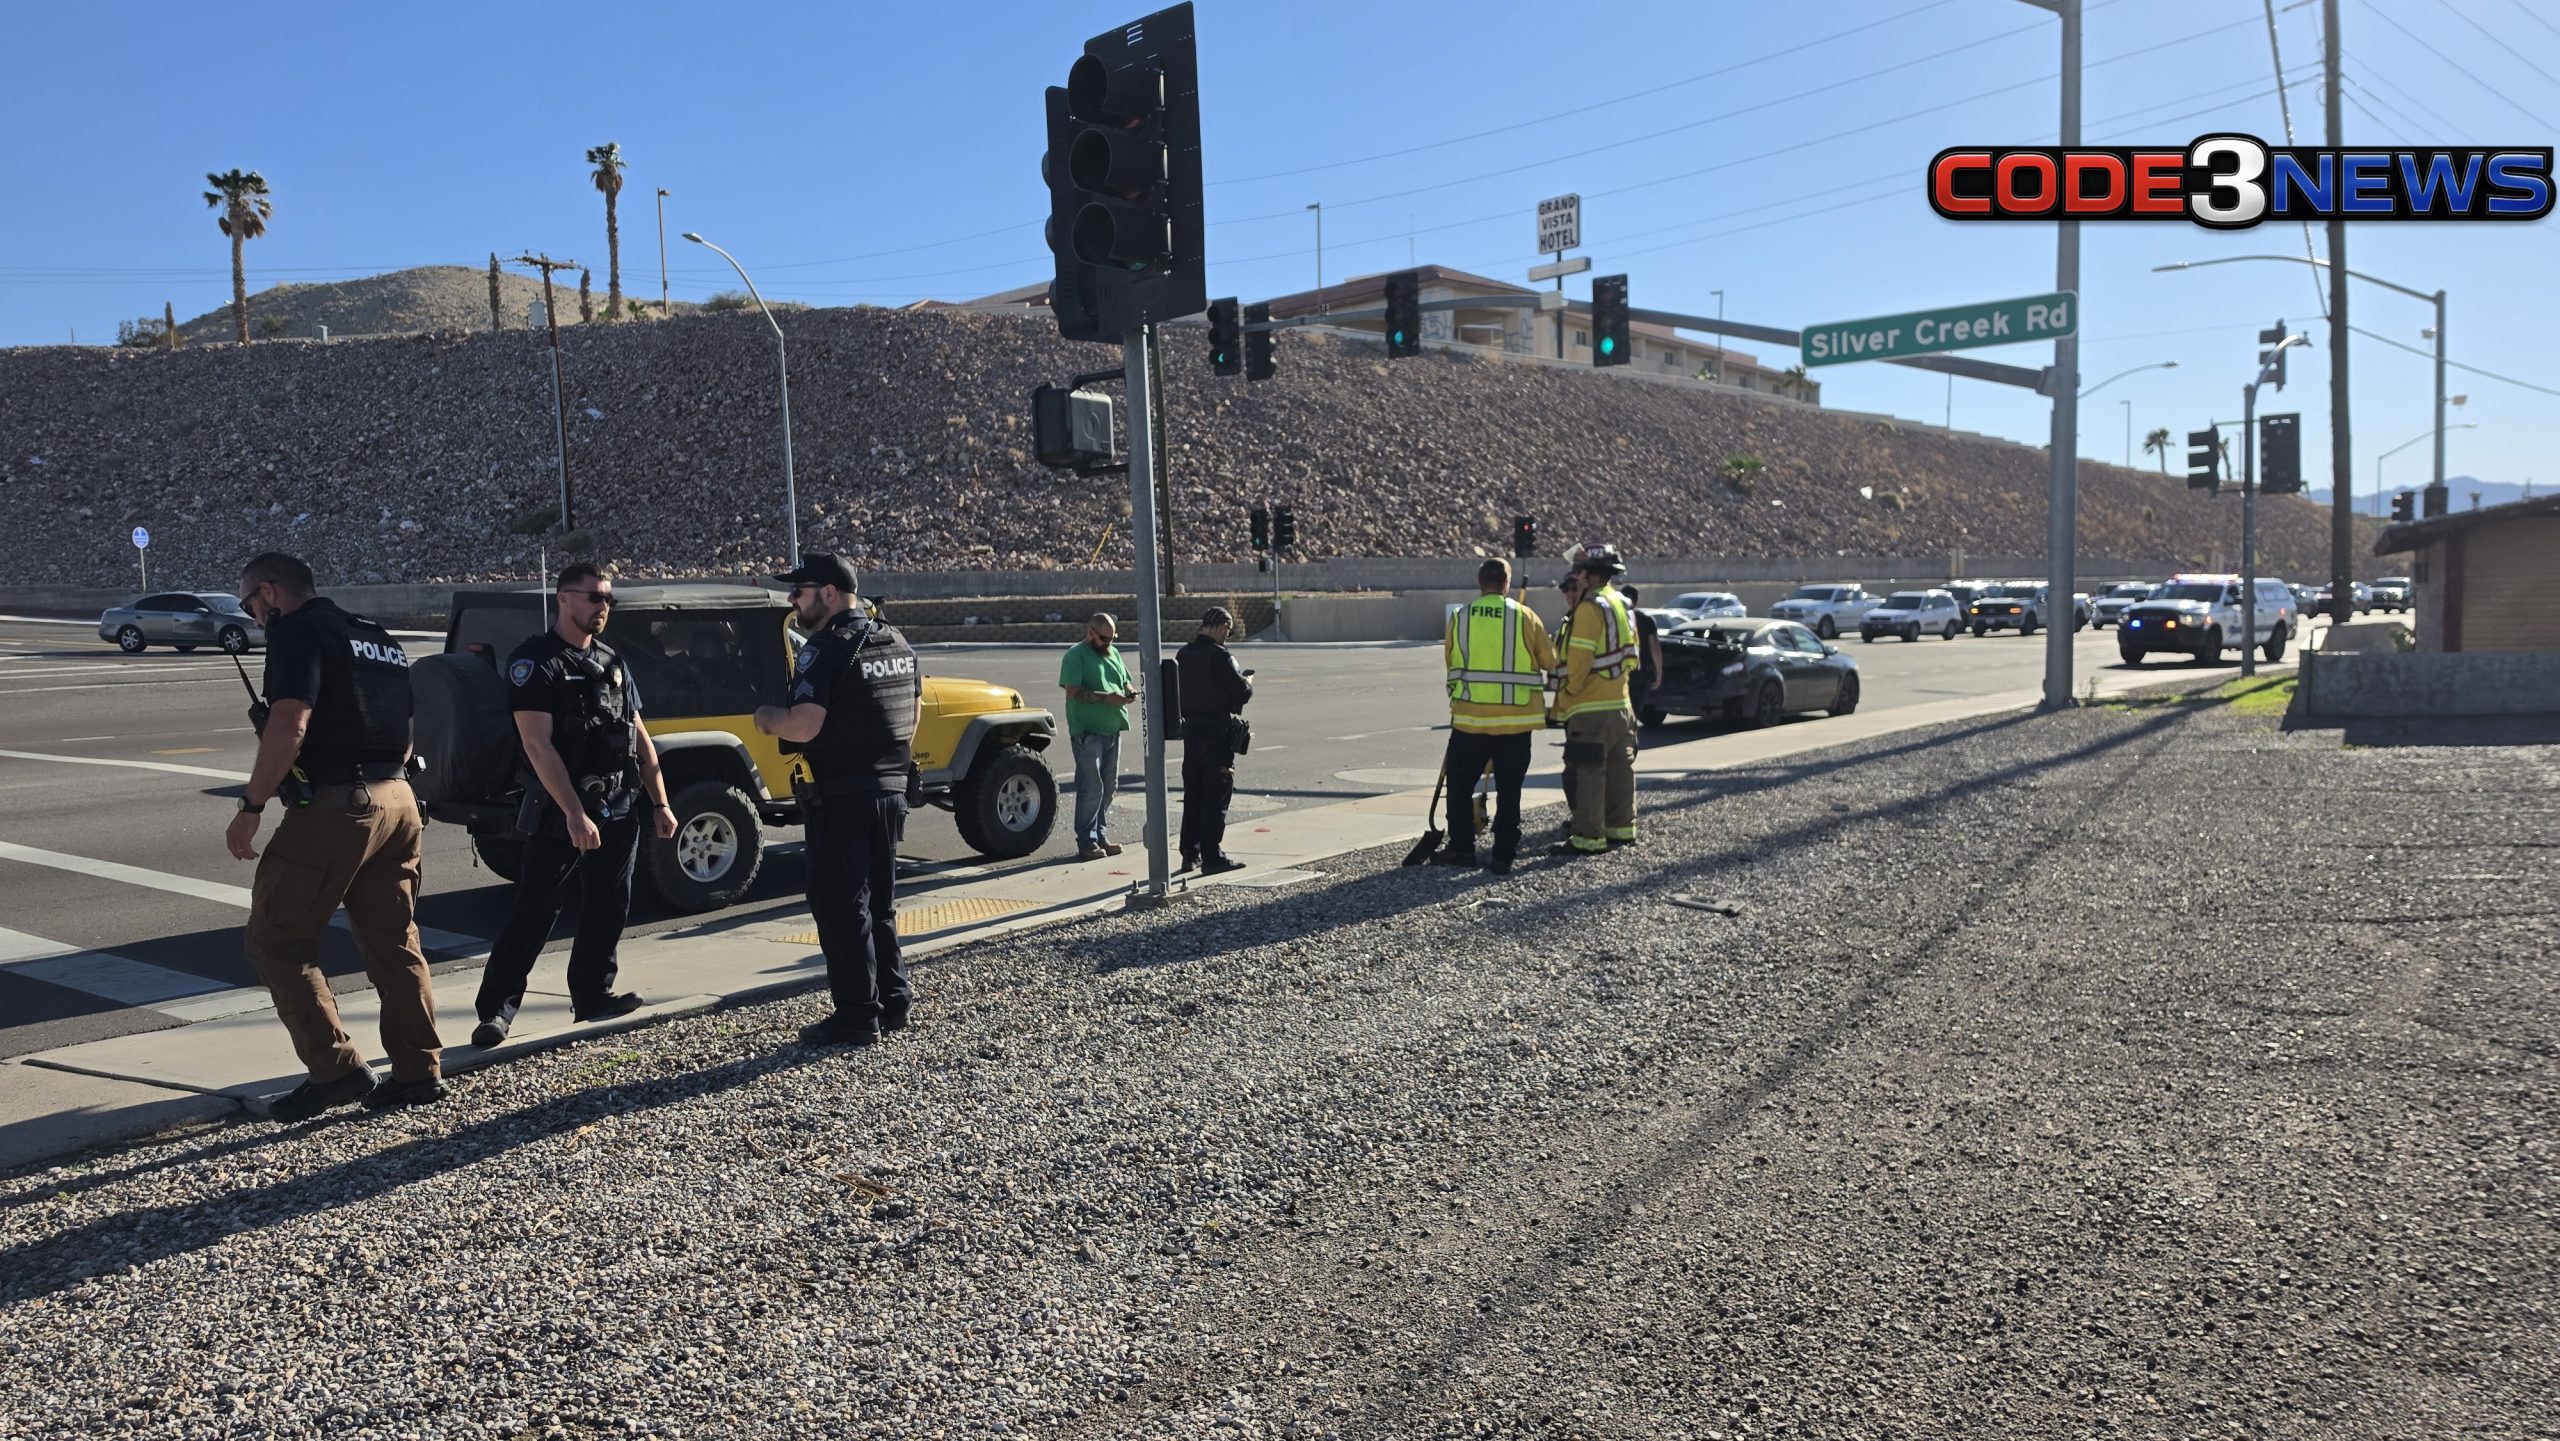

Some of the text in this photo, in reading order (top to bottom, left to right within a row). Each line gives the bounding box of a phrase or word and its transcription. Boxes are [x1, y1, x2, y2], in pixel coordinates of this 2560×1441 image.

[1539, 196, 1575, 216] GRAND
[1541, 212, 1572, 230] VISTA
[1540, 228, 1575, 251] HOTEL
[1810, 301, 2068, 359] Silver Creek Rd
[1471, 605, 1503, 619] FIRE
[349, 639, 408, 668] POLICE
[861, 656, 915, 680] POLICE
[912, 751, 930, 760] Jeep
